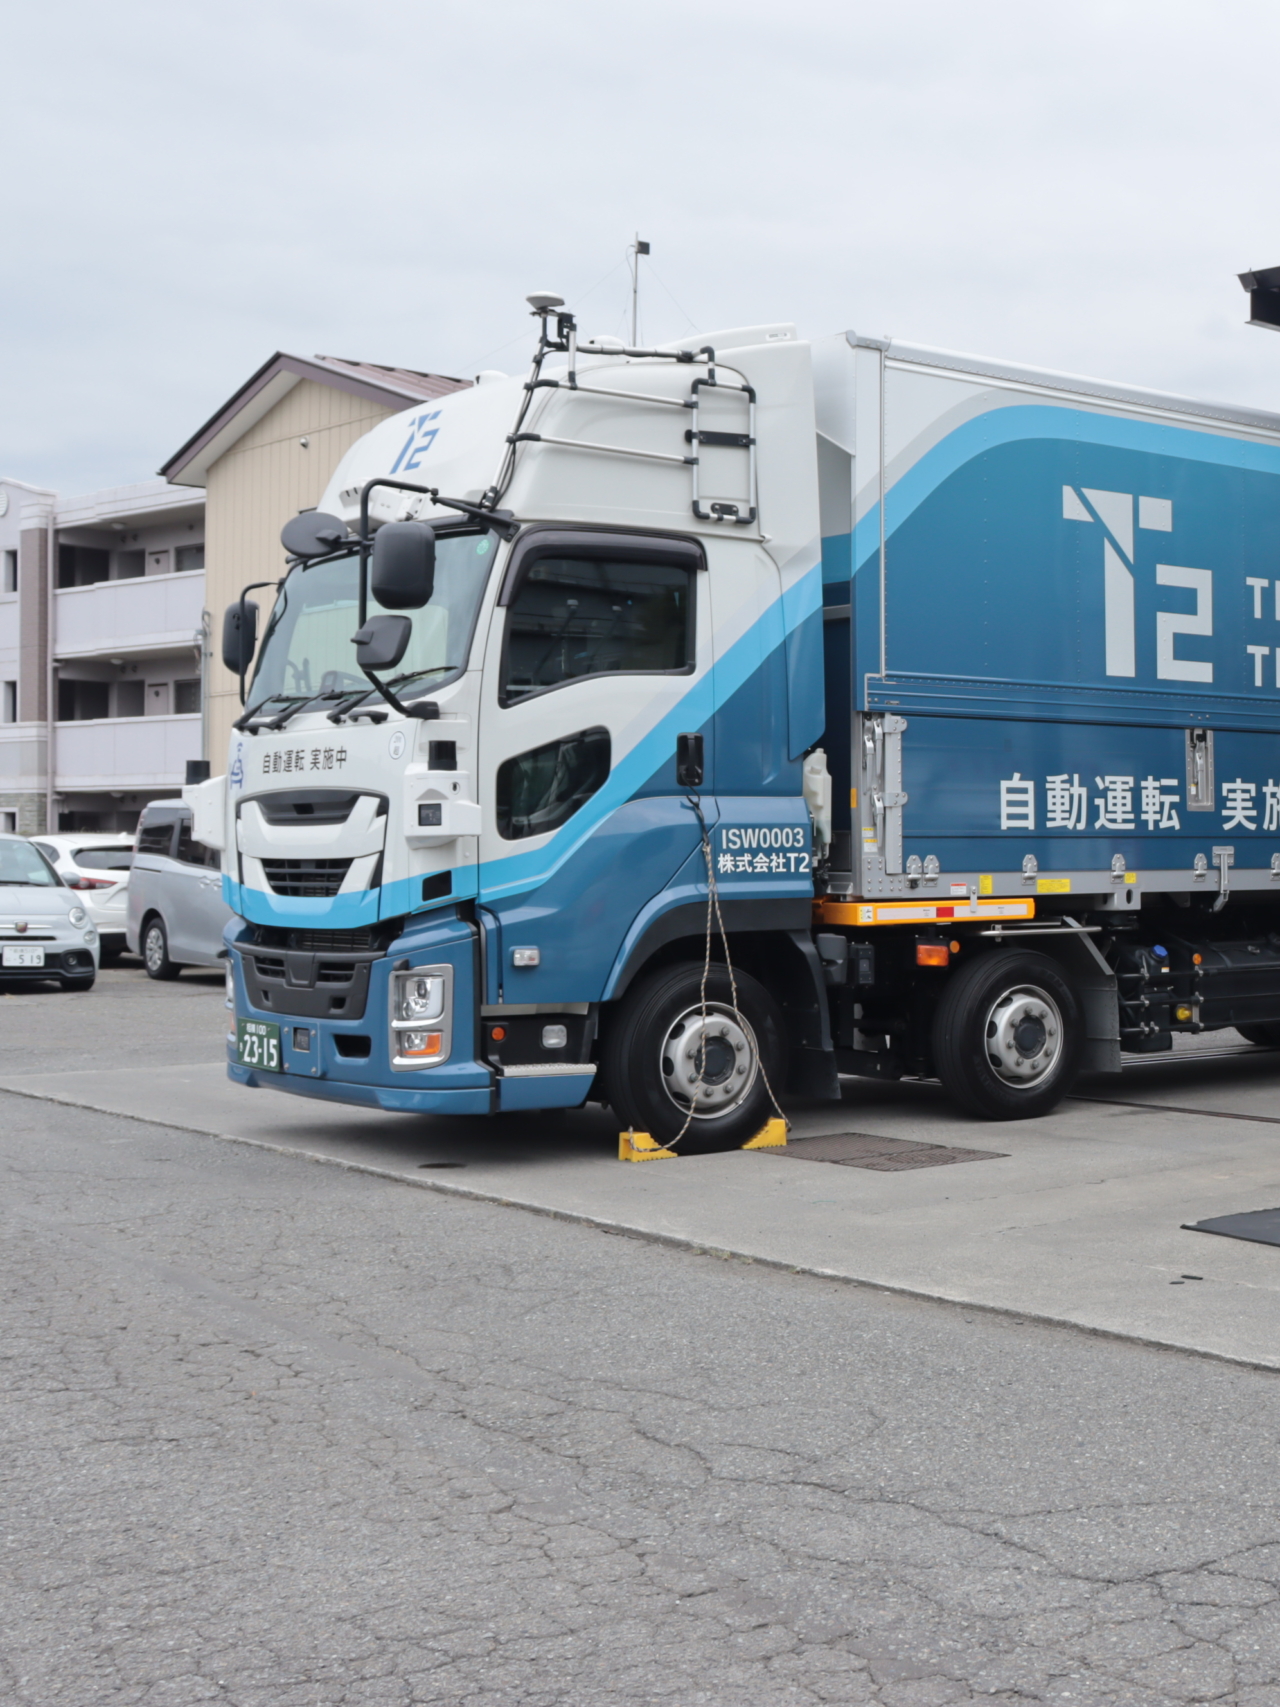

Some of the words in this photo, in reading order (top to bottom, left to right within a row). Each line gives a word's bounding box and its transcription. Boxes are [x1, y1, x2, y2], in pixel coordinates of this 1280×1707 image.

[387, 409, 443, 475] T2
[1062, 484, 1213, 683] T2
[721, 827, 804, 849] ISW0003
[717, 852, 810, 874] 株式会社T2
[243, 1034, 278, 1067] 23-15
